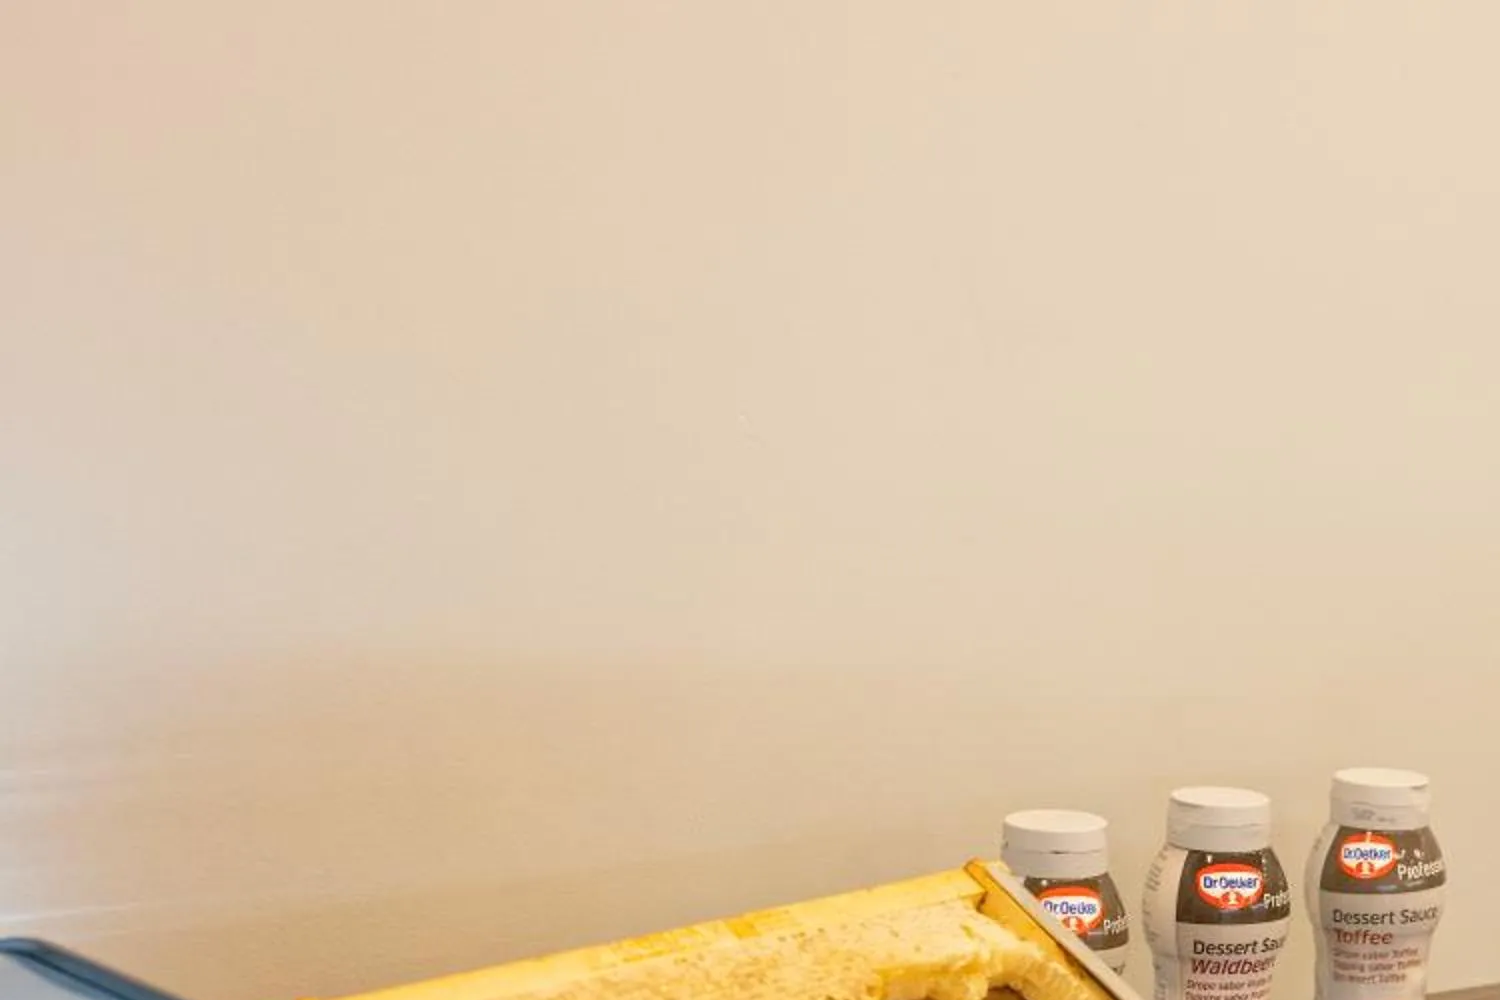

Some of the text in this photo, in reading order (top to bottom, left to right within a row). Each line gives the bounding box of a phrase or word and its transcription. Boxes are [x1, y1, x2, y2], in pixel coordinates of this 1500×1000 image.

[1333, 908, 1395, 925] Dessert
[1334, 927, 1393, 945] Toffee
[1193, 939, 1258, 956] Dessert
